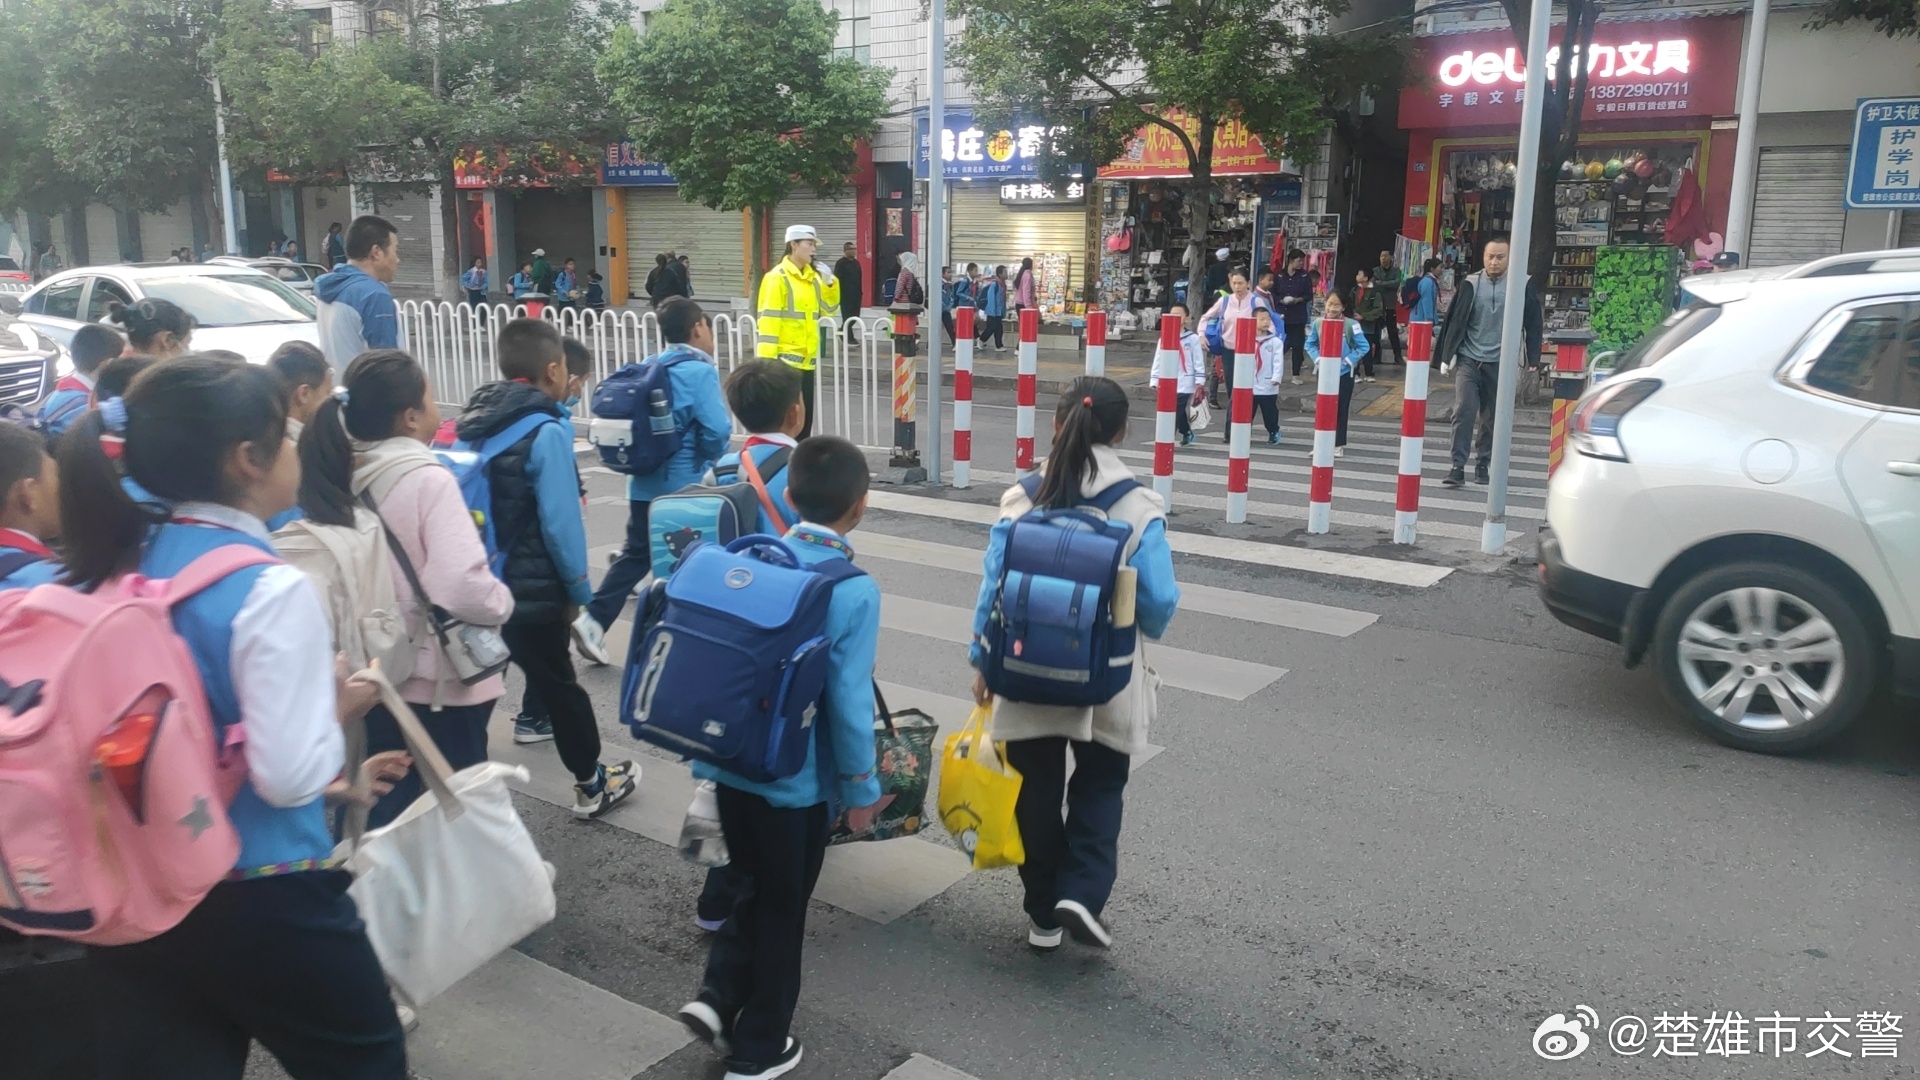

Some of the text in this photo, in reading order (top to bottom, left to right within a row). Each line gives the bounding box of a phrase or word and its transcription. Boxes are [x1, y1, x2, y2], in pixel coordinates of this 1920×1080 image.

[1589, 82, 1688, 99] 13872990711
[1866, 105, 1920, 121] 护卫天使
[1885, 128, 1916, 187] 护学岗
